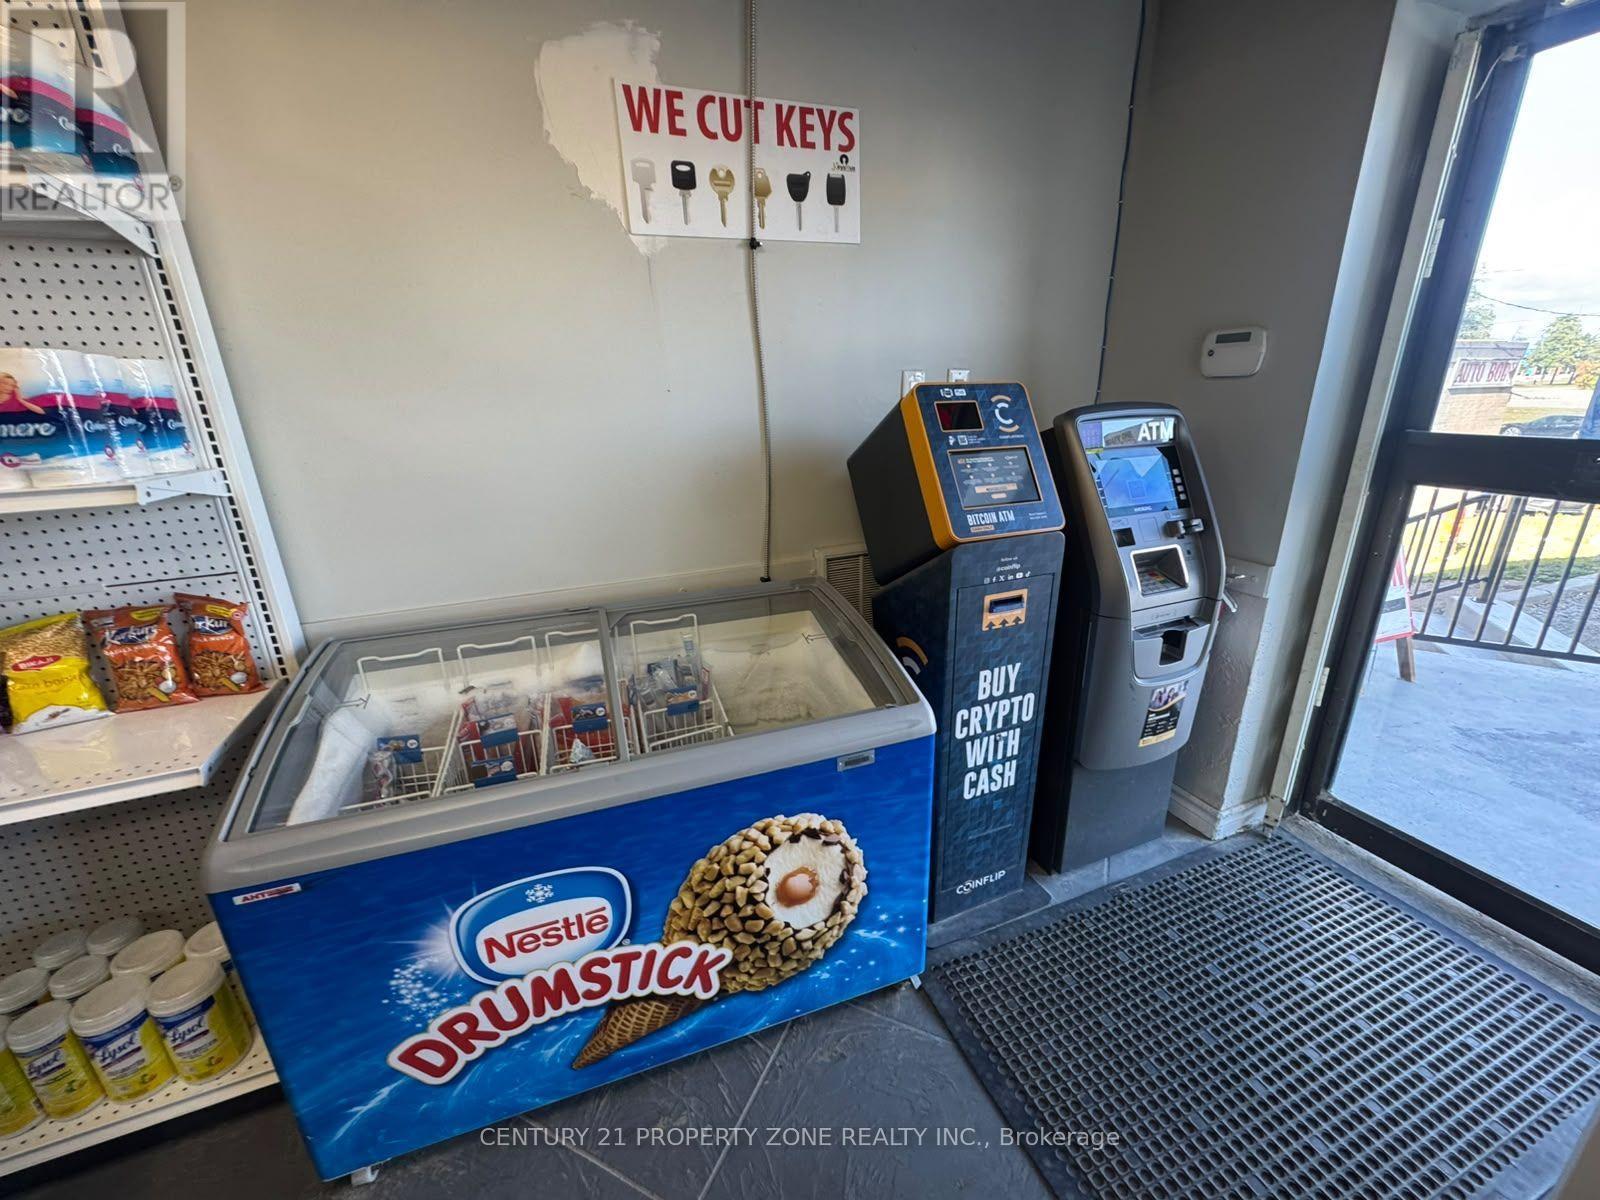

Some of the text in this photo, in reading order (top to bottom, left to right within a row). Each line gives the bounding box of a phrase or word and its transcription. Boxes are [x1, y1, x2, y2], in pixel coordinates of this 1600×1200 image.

[622, 84, 856, 152] WE CUT KEYS
[1455, 361, 1485, 383] AUTO
[1137, 417, 1175, 442] ATM
[967, 511, 998, 526] BITCOIN
[998, 509, 1016, 522] ATM
[978, 663, 1021, 700] BUY
[955, 693, 1035, 739] CRYPTO
[966, 728, 1021, 768] WITH
[963, 760, 1017, 799] CASH
[956, 870, 1007, 894] COINFLIP
[169, 1014, 208, 1043] Lysol
[398, 945, 726, 1079] DRUMSTICK
[99, 1031, 137, 1063] Lysol
